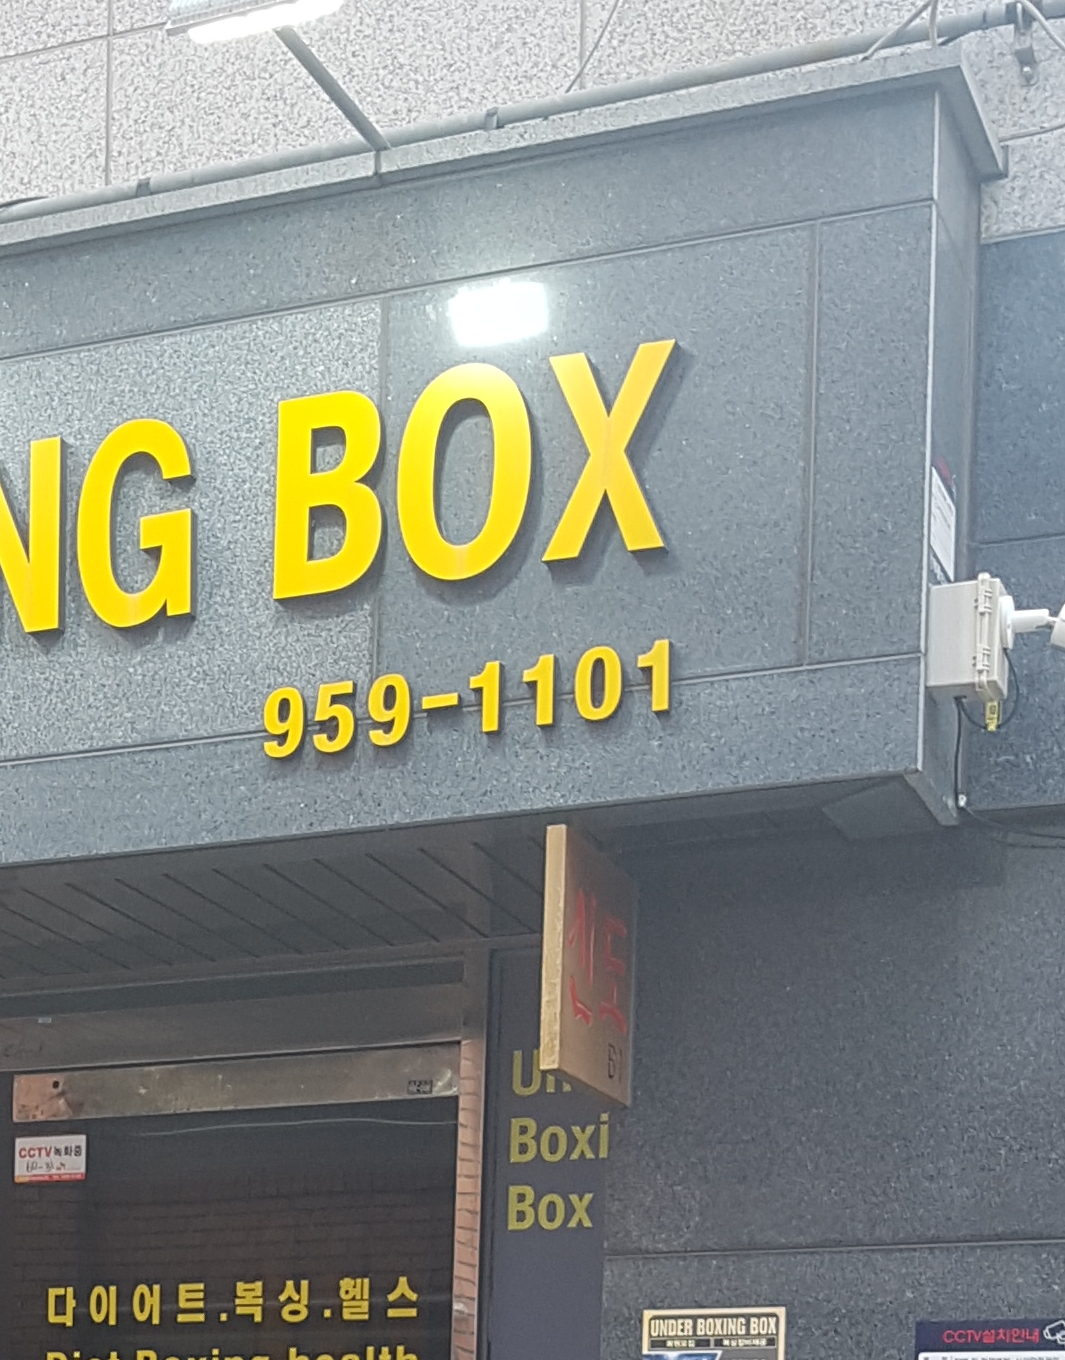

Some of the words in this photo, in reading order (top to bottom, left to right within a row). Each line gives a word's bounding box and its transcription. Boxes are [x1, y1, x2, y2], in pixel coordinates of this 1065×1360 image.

[273, 339, 677, 602] BOX
[263, 639, 671, 759] 959-1101
[507, 1185, 593, 1231] Box
[650, 1319, 693, 1337] UNDER
[696, 1317, 746, 1336] BOXING
[749, 1316, 777, 1335] BOX
